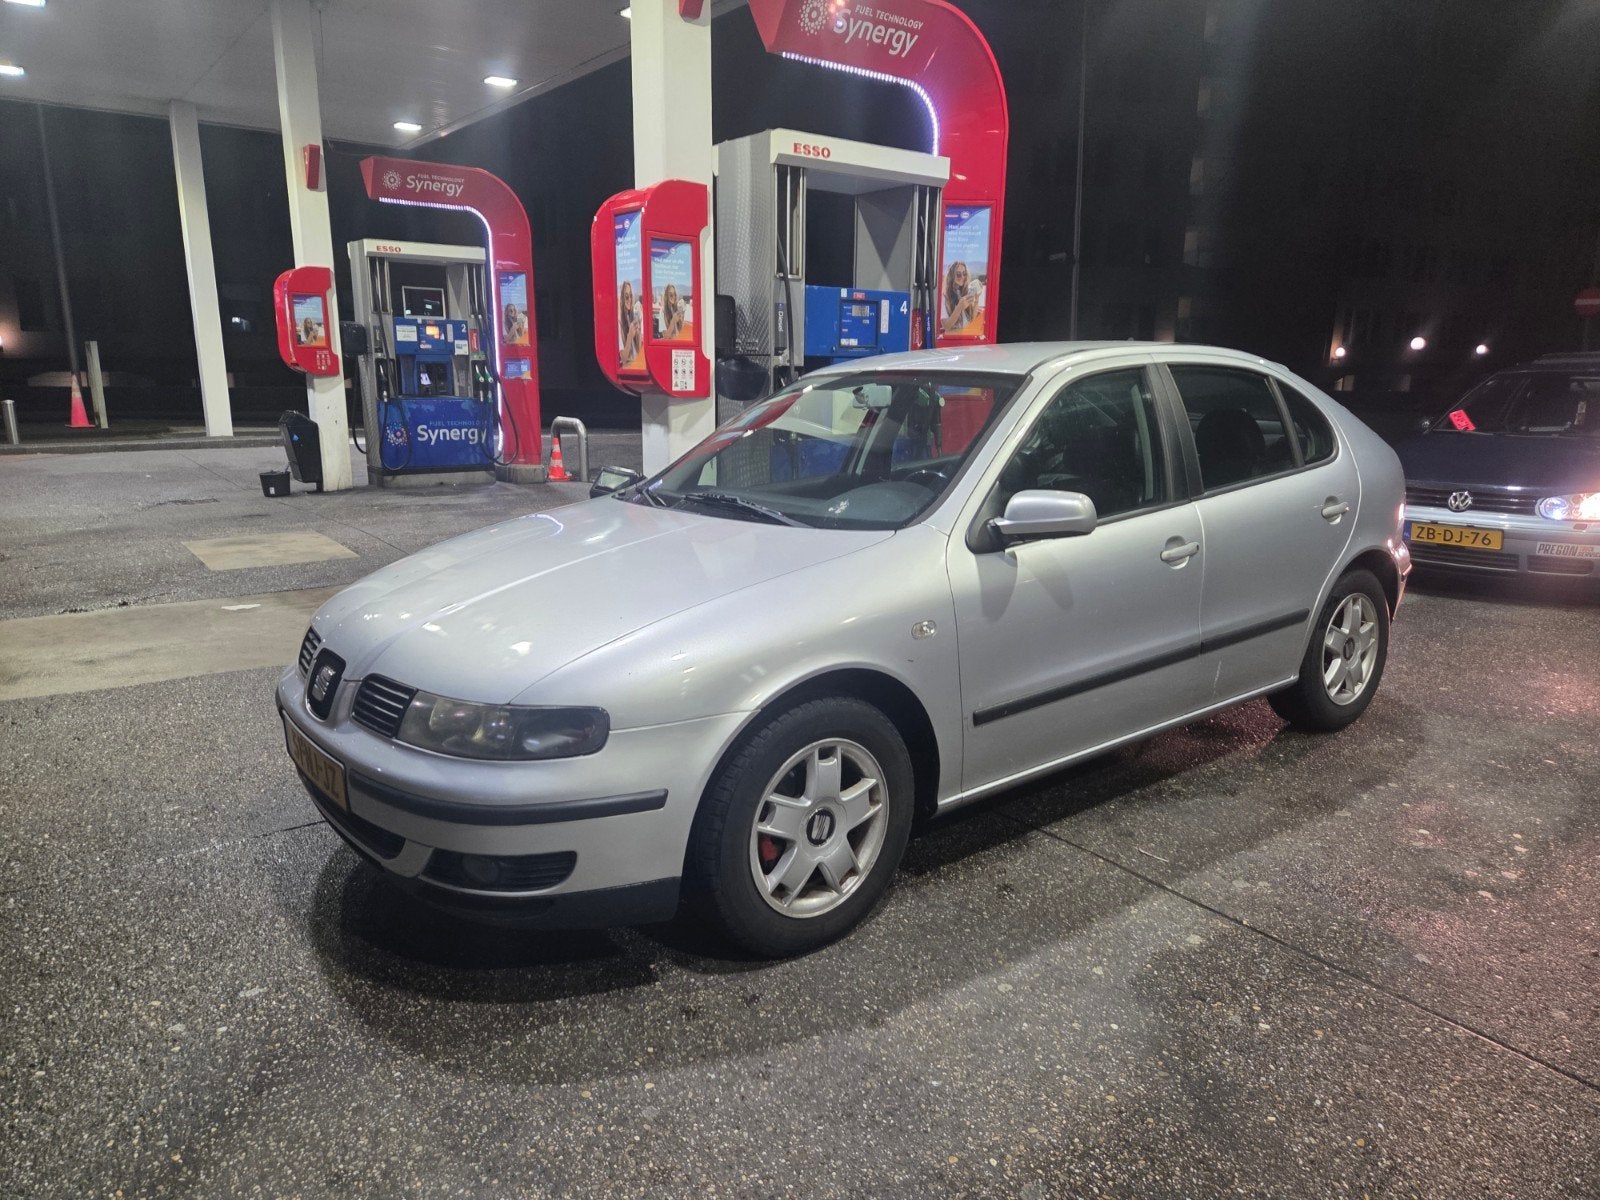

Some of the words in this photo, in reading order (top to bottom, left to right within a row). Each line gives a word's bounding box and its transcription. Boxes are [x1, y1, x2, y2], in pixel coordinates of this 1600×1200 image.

[855, 5, 874, 17] FUEL
[876, 9, 924, 30] TECHNOLOGY
[833, 8, 919, 58] Synergy
[793, 142, 831, 159] ESSO
[406, 175, 464, 197] Synergy
[376, 245, 402, 253] ESSO
[899, 300, 908, 315] 4
[461, 323, 467, 333] 2
[416, 424, 487, 446] Synergy
[1416, 525, 1492, 546] ZB-DJ-76
[1537, 543, 1579, 557] PREGON
